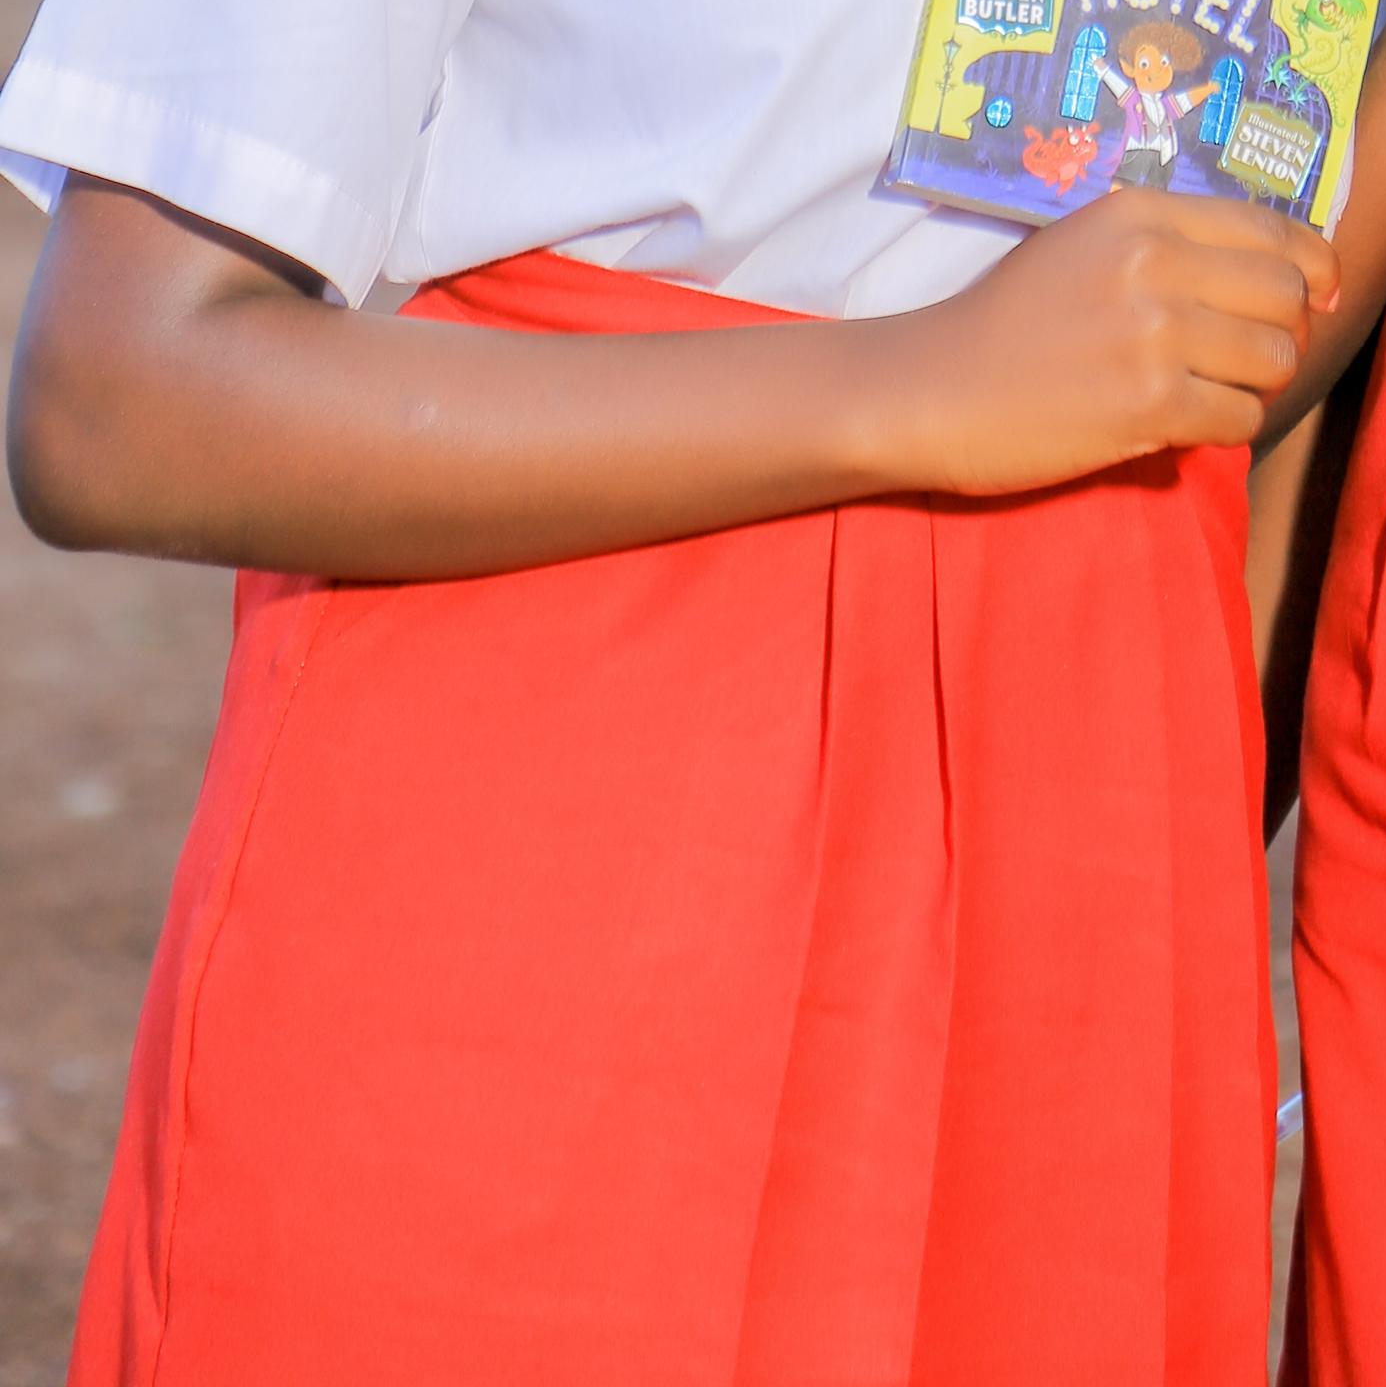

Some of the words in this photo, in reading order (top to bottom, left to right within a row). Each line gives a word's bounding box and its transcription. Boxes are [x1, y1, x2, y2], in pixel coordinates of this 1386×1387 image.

[1238, 124, 1309, 168] STEVEN
[1248, 113, 1298, 143] Illustrated
[1298, 134, 1311, 150] by
[1231, 142, 1301, 187] LENTON
